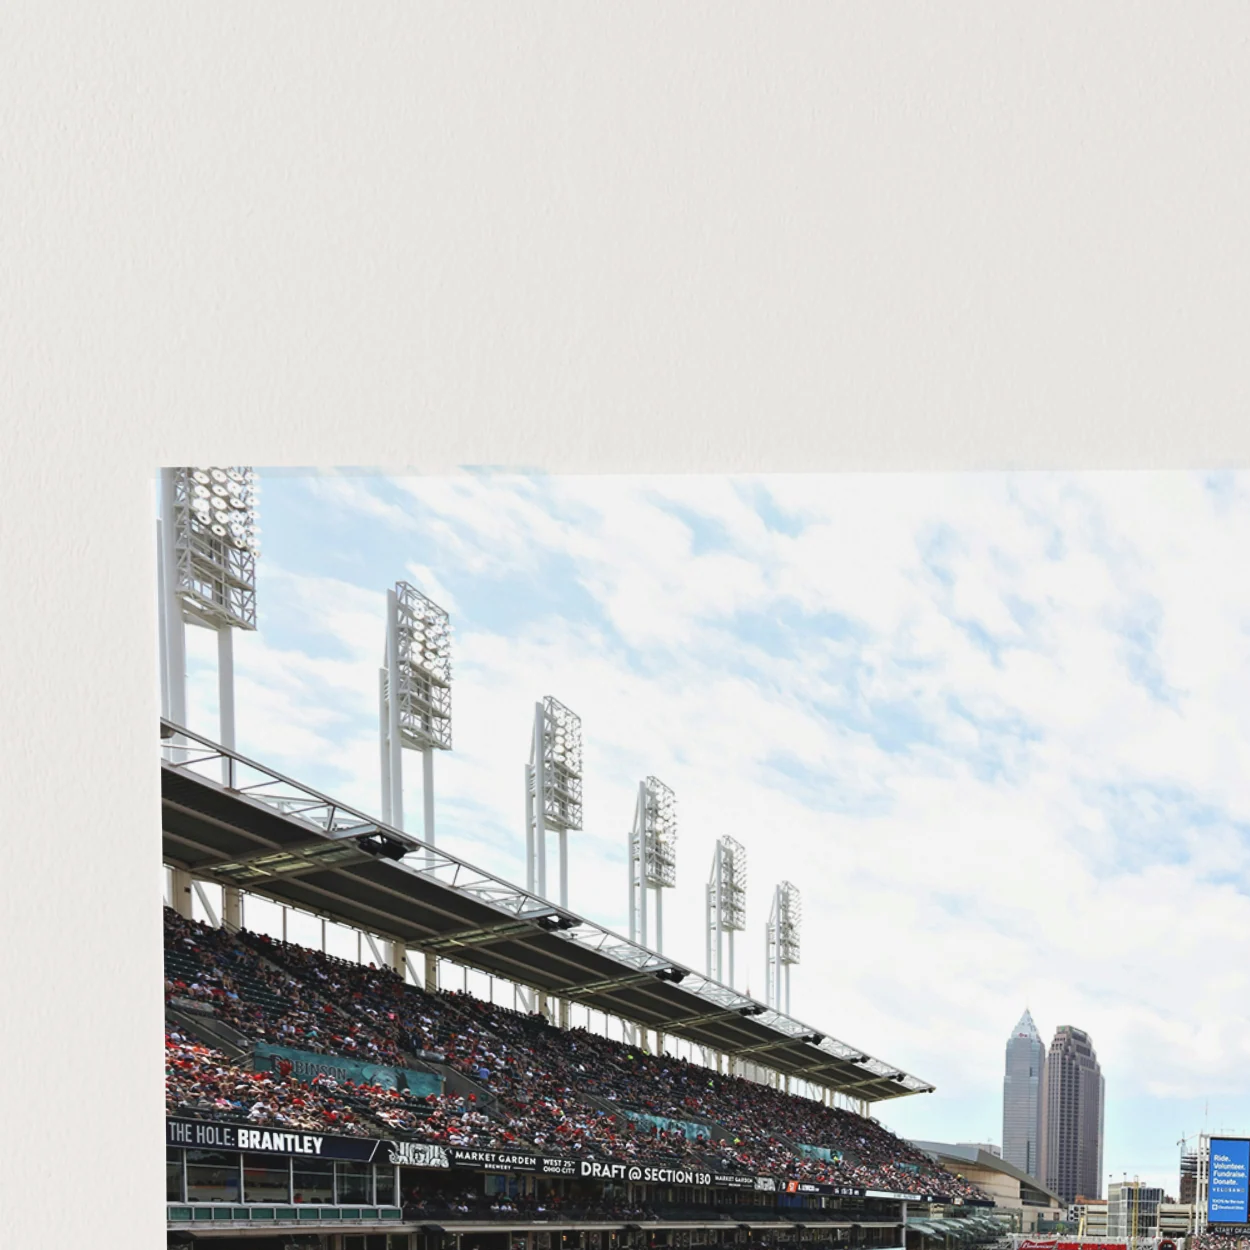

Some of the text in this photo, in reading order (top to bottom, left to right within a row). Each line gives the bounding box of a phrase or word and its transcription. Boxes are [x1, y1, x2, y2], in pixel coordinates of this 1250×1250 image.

[168, 1121, 323, 1154] THE HOLE: BRANTLEY
[455, 1151, 495, 1162] MARKET
[498, 1155, 536, 1165] GARDEN
[1213, 1154, 1231, 1162] Ride.
[581, 1161, 711, 1185] DRAFT @ SECTION 130
[1022, 1240, 1054, 1249] Budweiser
